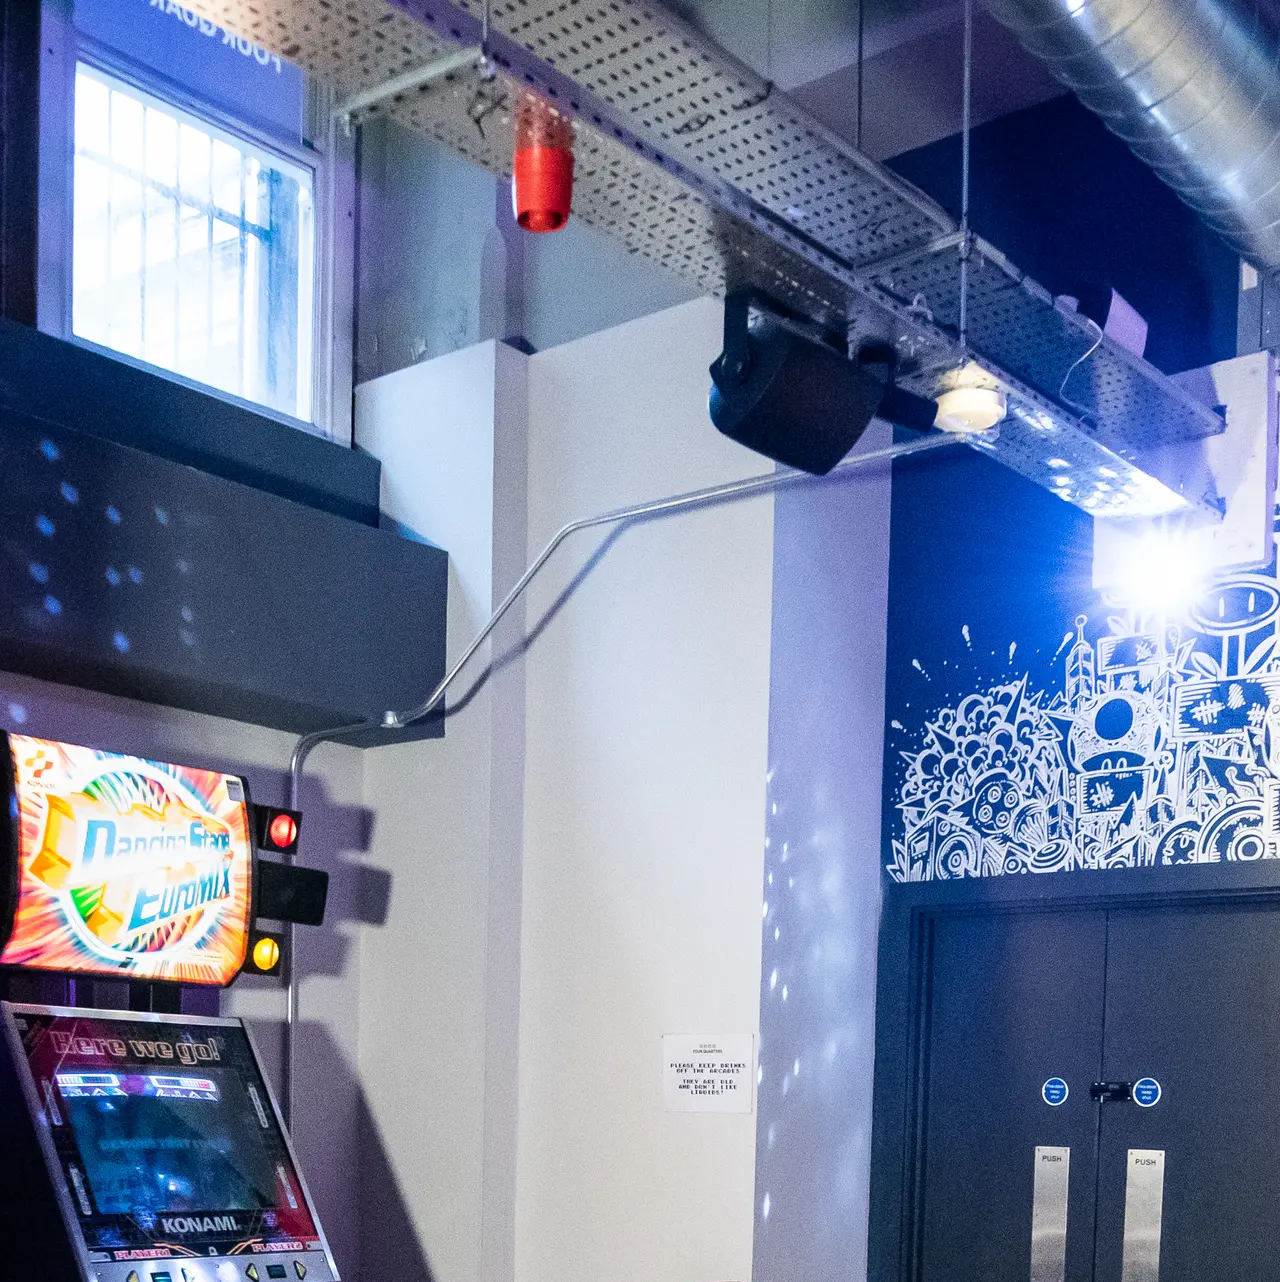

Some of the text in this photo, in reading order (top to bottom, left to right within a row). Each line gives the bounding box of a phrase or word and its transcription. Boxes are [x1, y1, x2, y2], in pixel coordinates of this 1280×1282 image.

[50, 1031, 221, 1065] Here we go!
[161, 1215, 238, 1234] KONAMI
